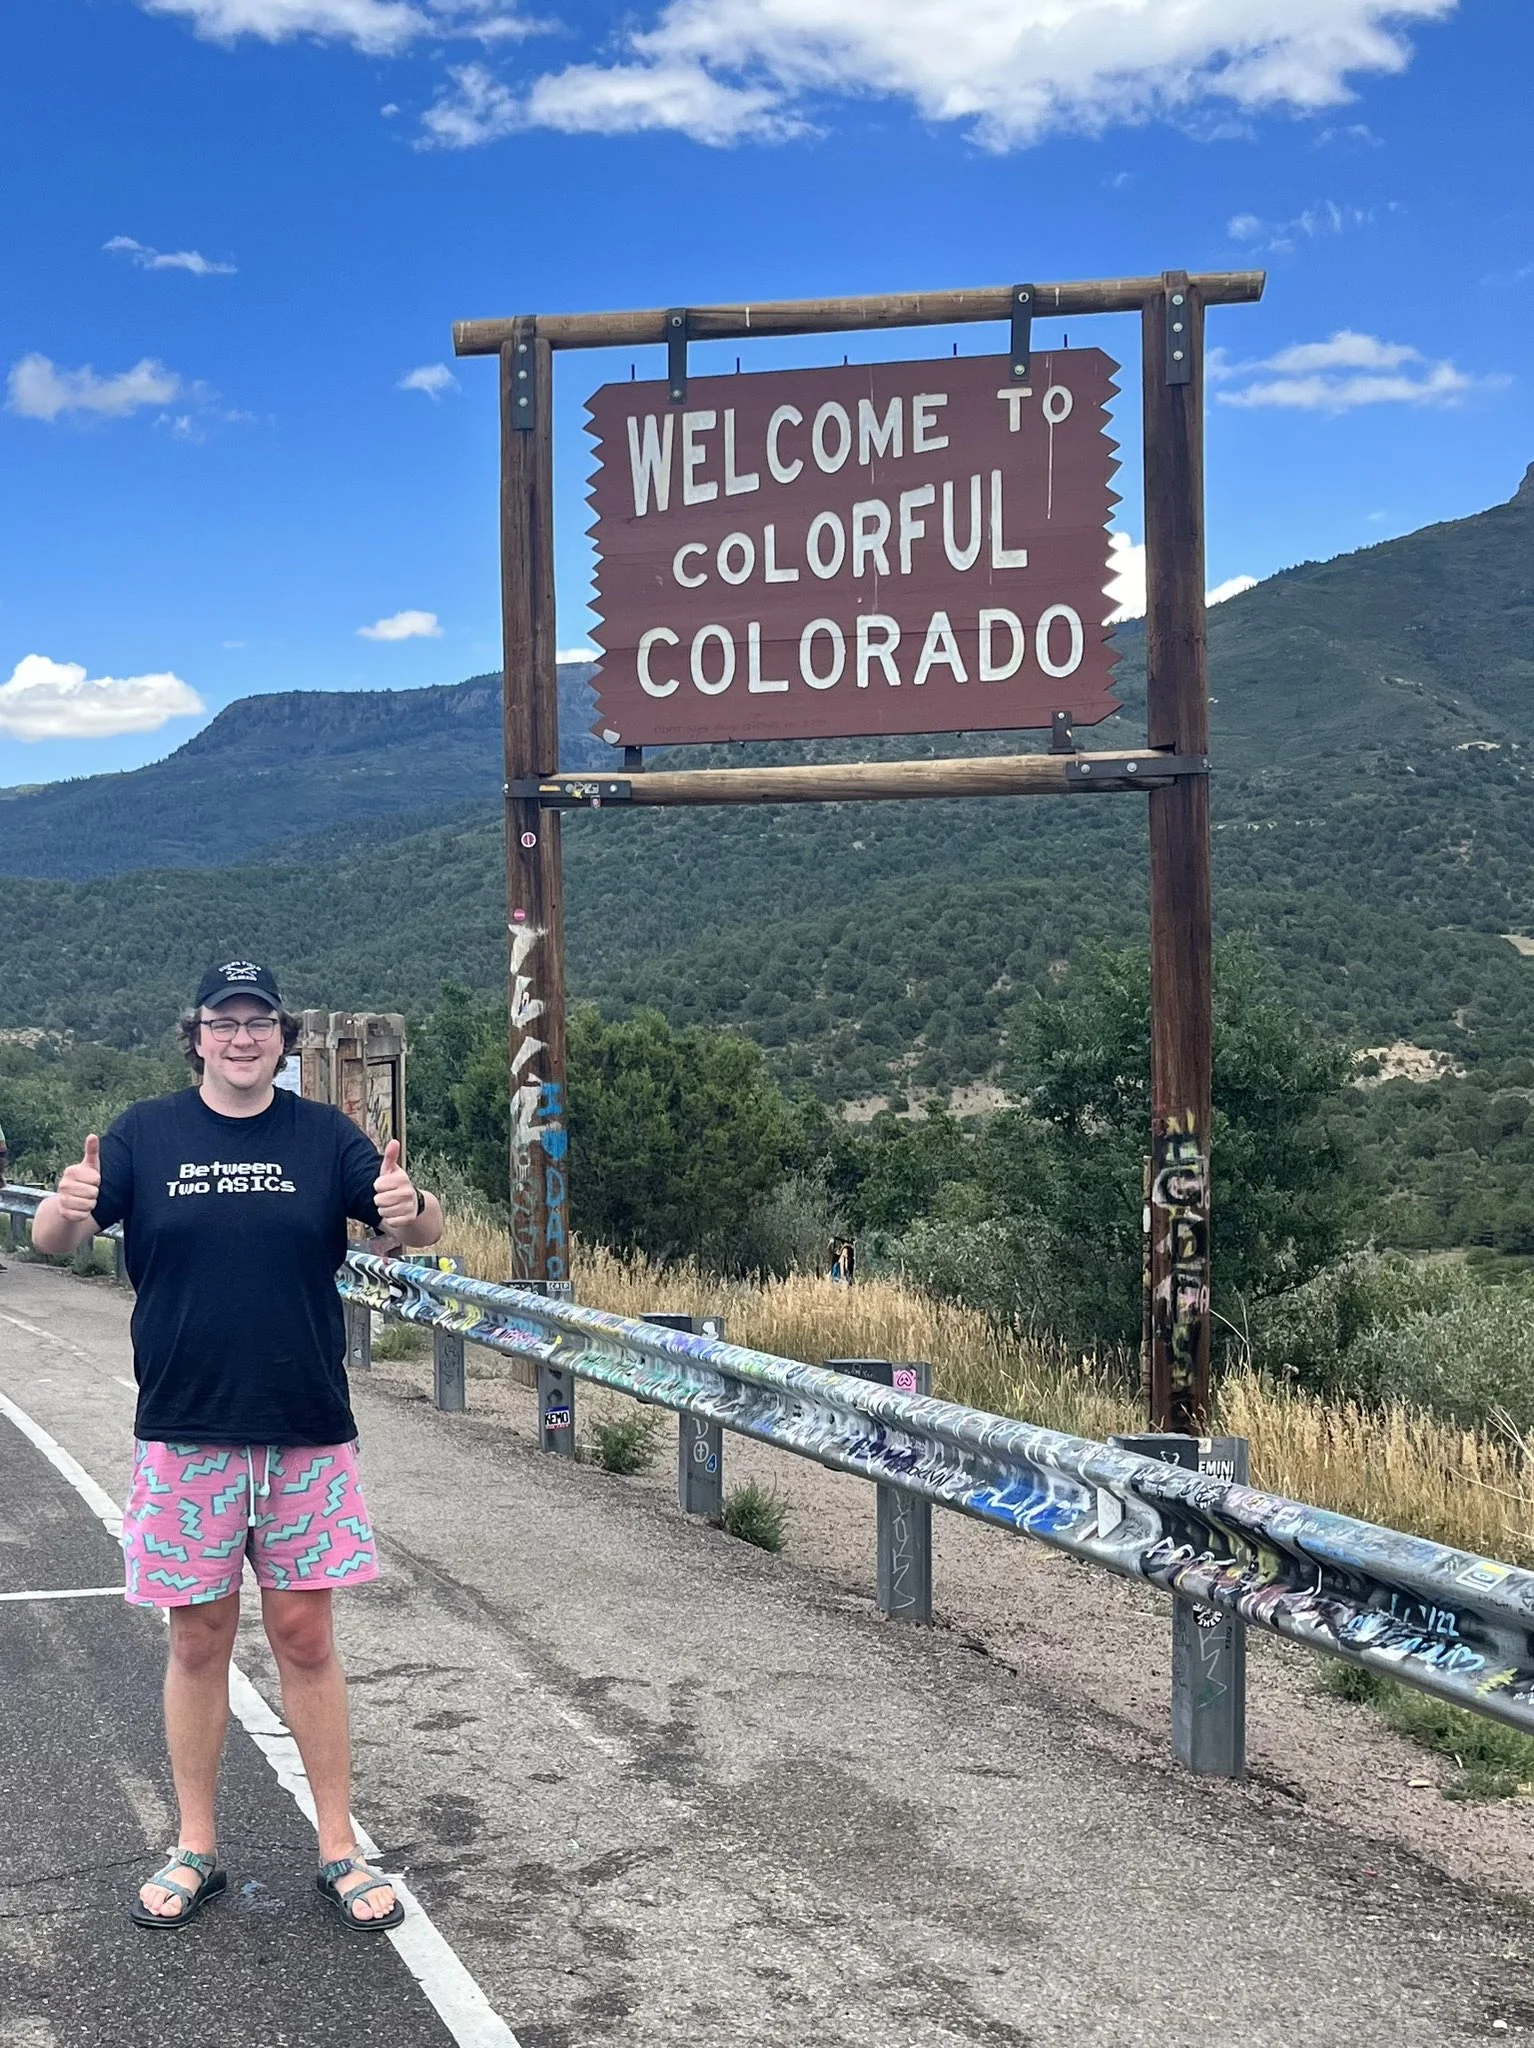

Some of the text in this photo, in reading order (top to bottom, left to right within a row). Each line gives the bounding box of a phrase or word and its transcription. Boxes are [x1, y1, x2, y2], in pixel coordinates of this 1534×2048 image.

[627, 385, 1074, 517] WELCOME TO
[673, 469, 1028, 588] COLORFUL
[637, 604, 1084, 698] COLORADO
[166, 1176, 297, 1197] Two ASICs
[179, 1161, 283, 1179] Between
